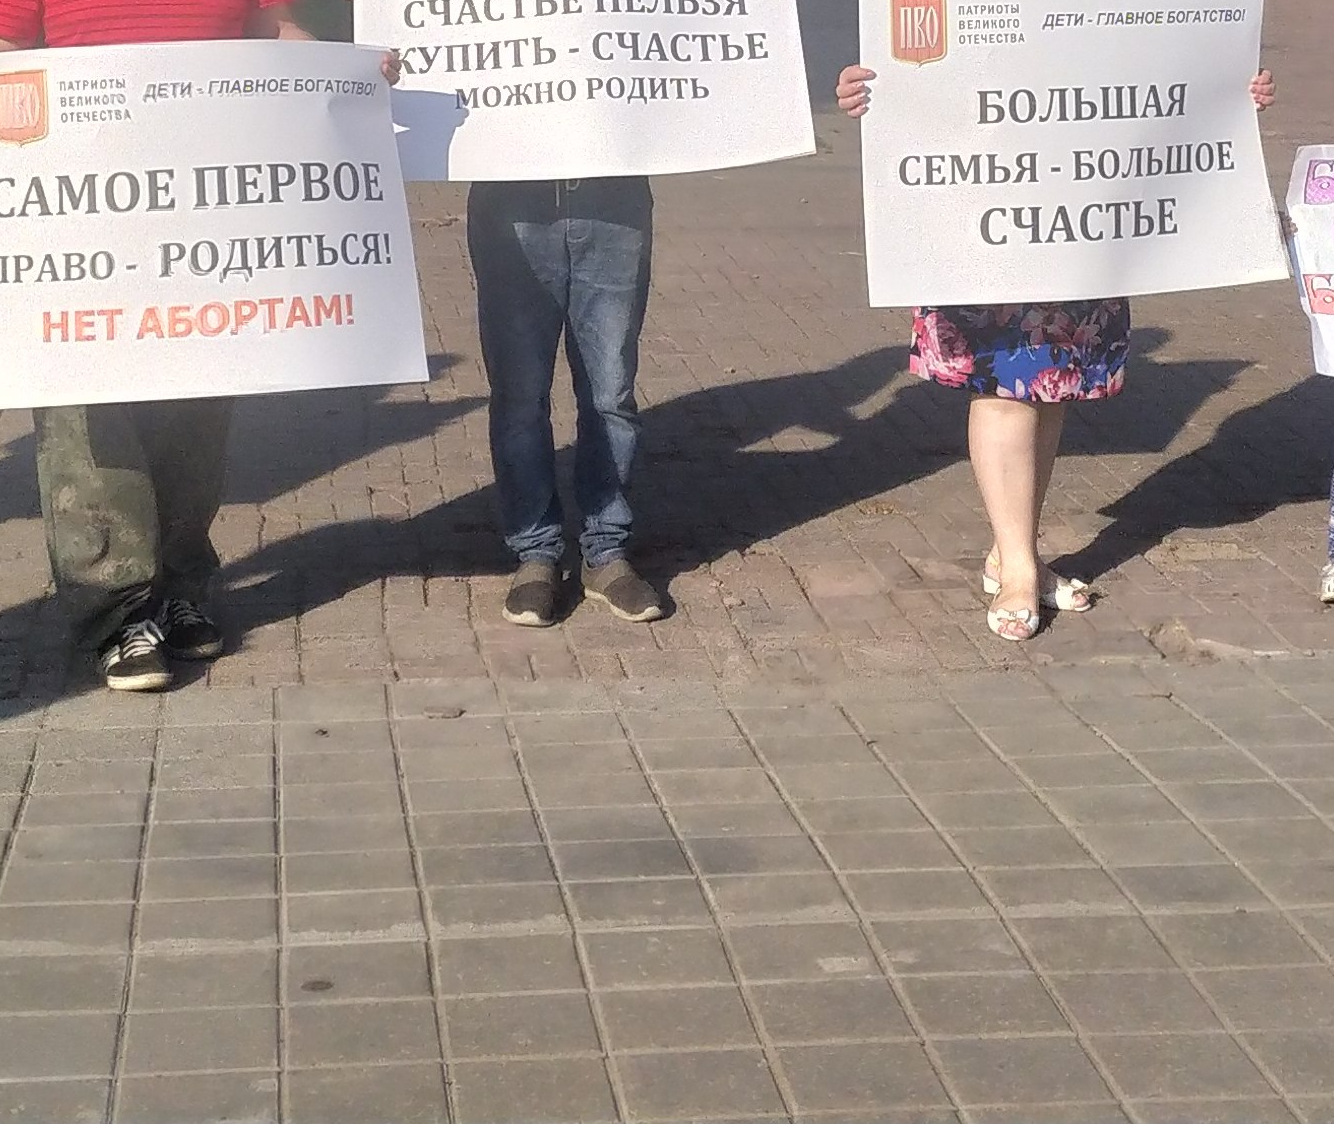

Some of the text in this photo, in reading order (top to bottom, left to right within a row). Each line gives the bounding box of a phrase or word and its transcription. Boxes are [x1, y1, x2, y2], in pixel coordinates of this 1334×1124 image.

[958, 4, 1020, 15] ПАТРИОТЫ
[958, 18, 1020, 30] ВЕЛИКОГО
[1042, 13, 1084, 30] ДЕТИ
[1096, 11, 1165, 26] ГЛАВНОЕ
[1166, 9, 1246, 24] БОГАТСТВО!
[900, 6, 938, 49] ПВО
[958, 33, 1025, 45] ОТЕЧЕСТВА
[389, 37, 557, 75] КУПИТЬ
[592, 32, 769, 62] СЧАСТЬЕ
[59, 78, 126, 92] ПАТРИОТЫ
[60, 93, 126, 107] ВЕЛИКОГО
[142, 82, 192, 103] ДЕТИ
[207, 79, 289, 96] ГЛАВНОЕ
[293, 78, 377, 96] БОГАТСТВО!
[455, 76, 709, 110] МОЖНО РОДИТЬ
[61, 109, 132, 124] ОТЕЧЕСТВА
[977, 83, 1188, 125] БОЛЬШАЯ
[899, 152, 1039, 187] СЕМЬЯ
[1072, 141, 1235, 181] БОЛЬШОЕ
[193, 162, 384, 209] ПЕРВОЕ
[980, 198, 1178, 246] СЧАСТЬЕ
[159, 232, 392, 283] РОДИТЬСЯ!
[42, 293, 355, 343] НЕТ АБОРТАМ!
